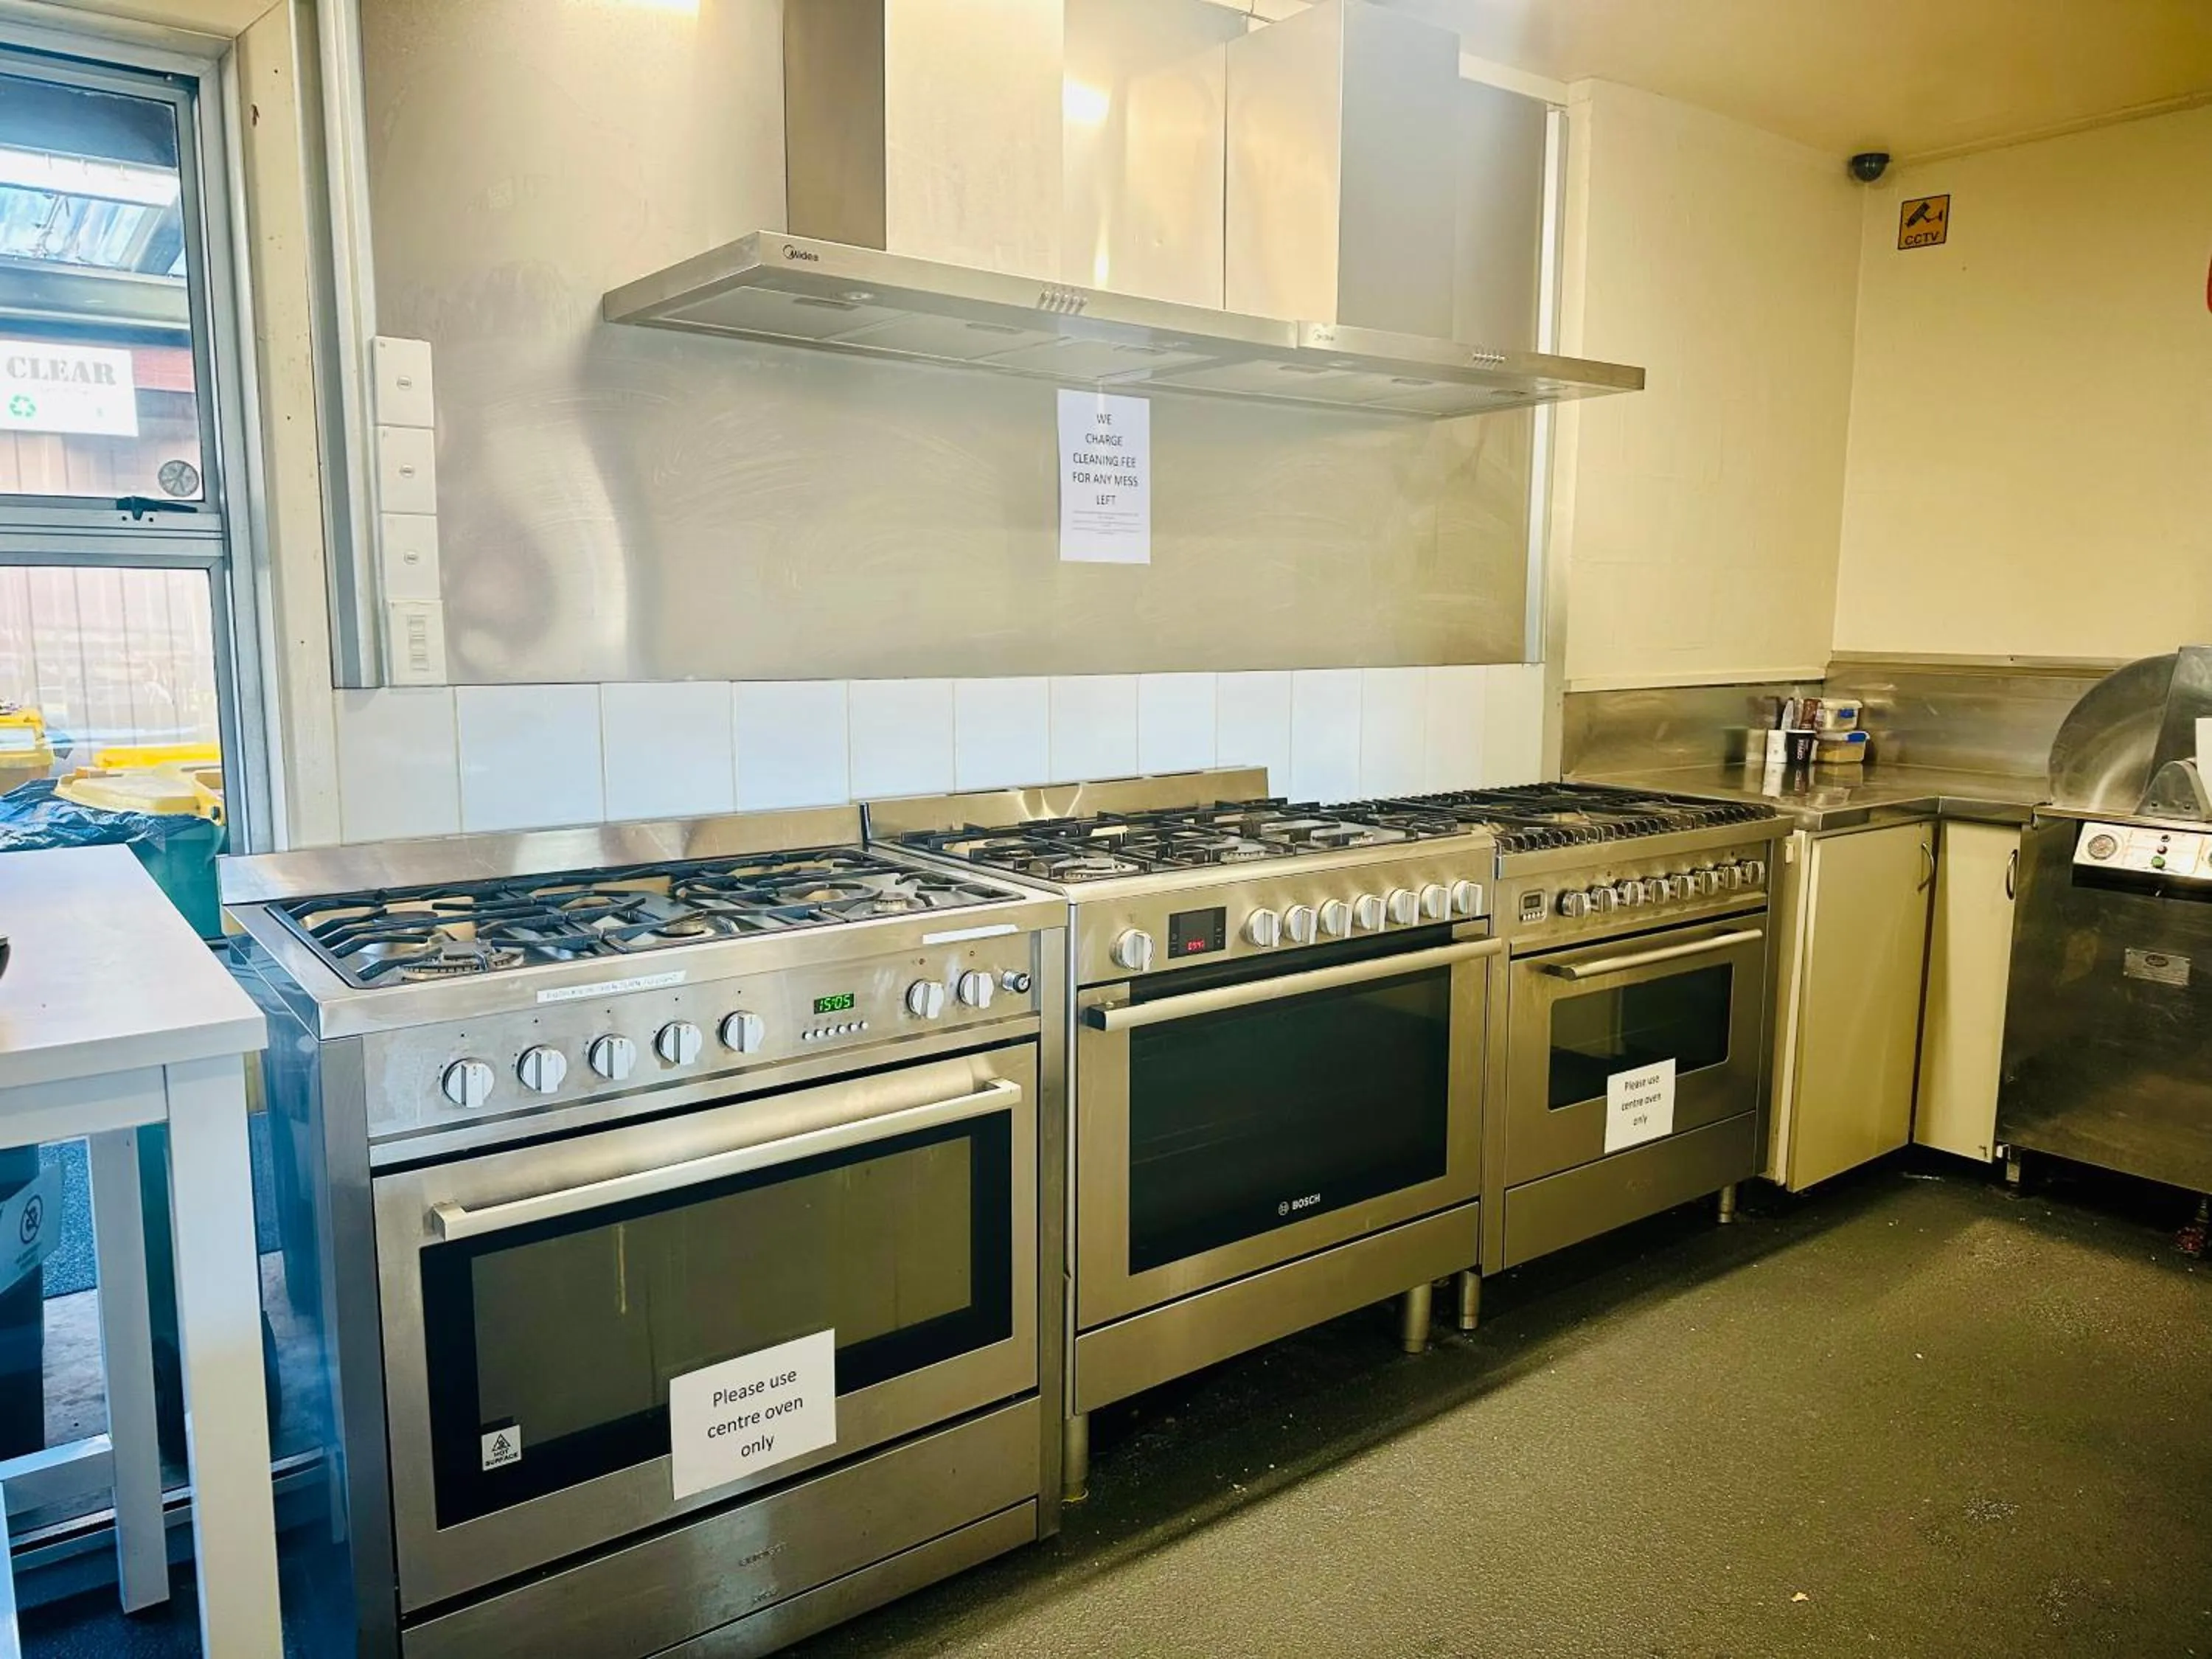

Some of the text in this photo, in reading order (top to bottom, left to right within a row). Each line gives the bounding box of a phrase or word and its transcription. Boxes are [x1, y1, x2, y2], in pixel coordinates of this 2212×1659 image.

[1905, 232, 1940, 245] CCTV
[6, 355, 117, 385] CLEAR
[1096, 414, 1112, 425] WE
[1085, 433, 1123, 446] CHARGE
[1073, 452, 1136, 468] CLEANING FEE
[1073, 472, 1138, 487] FOR ANY MESS
[1096, 494, 1116, 505] LEFT
[819, 995, 850, 1011] 15:05
[1624, 1075, 1660, 1091] Please use
[1621, 1093, 1661, 1111] centre oven
[1292, 1193, 1321, 1209] BOSCH
[712, 1370, 797, 1408] Please use
[707, 1397, 803, 1439] centre oven
[740, 1435, 775, 1457] only
